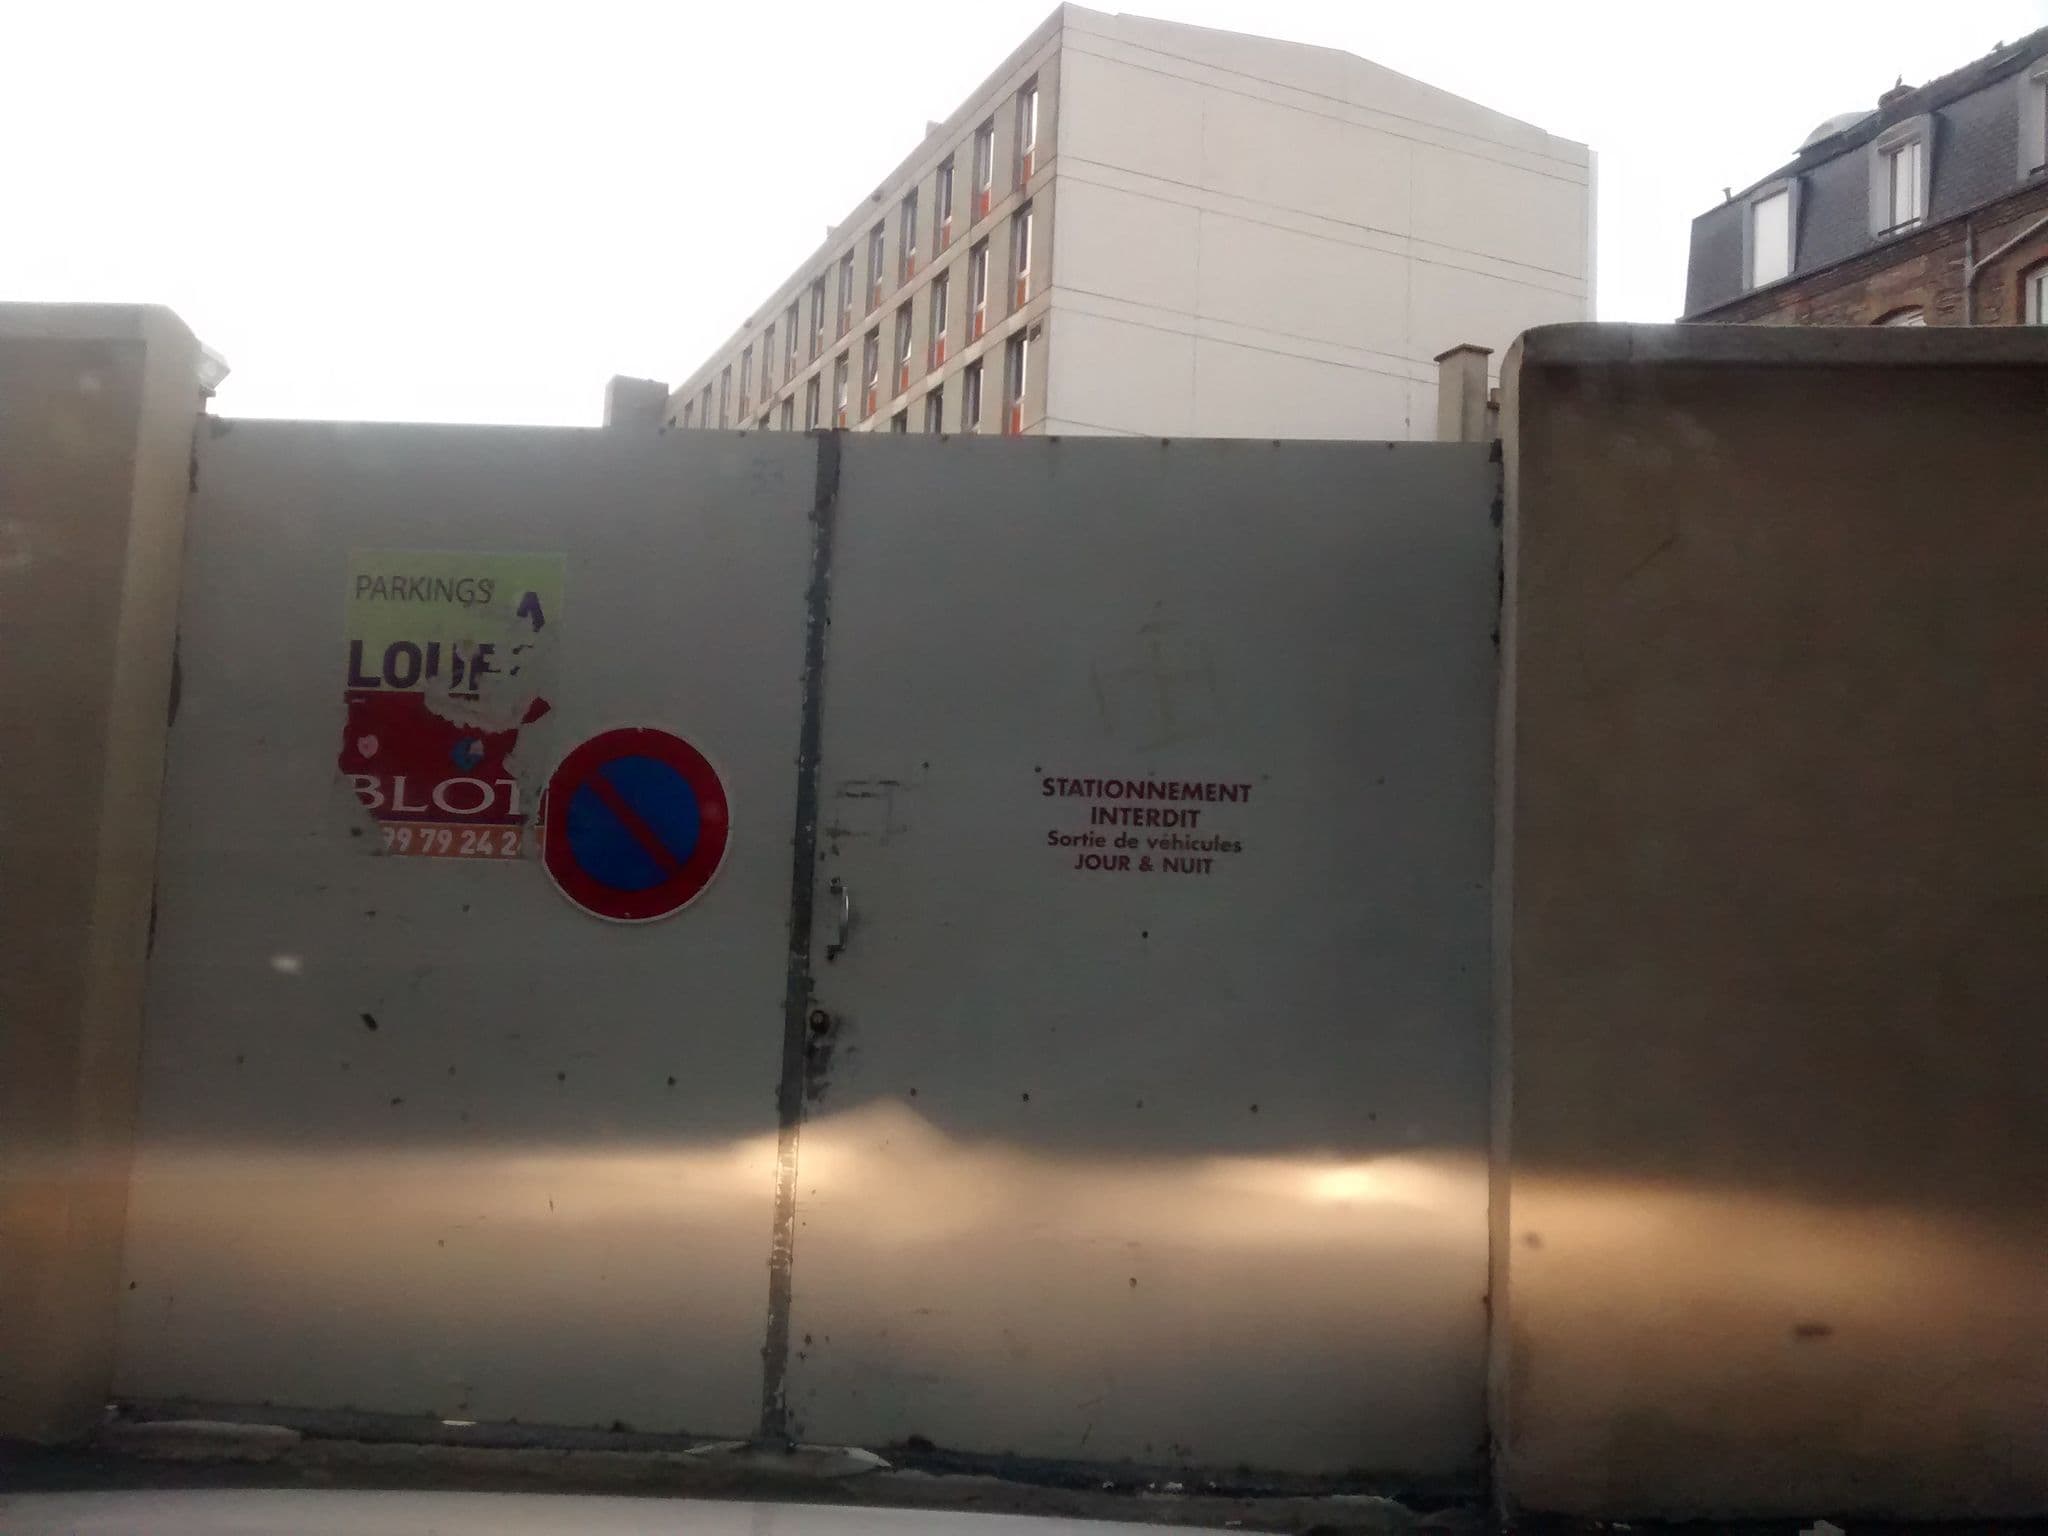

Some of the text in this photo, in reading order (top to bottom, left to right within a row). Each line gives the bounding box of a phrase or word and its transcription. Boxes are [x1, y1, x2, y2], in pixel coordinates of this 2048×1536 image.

[356, 575, 495, 604] PARKINGS
[1042, 777, 1252, 803] STATIONNEMENT
[1090, 806, 1201, 828] INTERDIT
[420, 828, 453, 853] 79
[1047, 830, 1106, 847] Sortie
[1114, 832, 1139, 849] de
[1074, 854, 1214, 875] JOUR & NUIT
